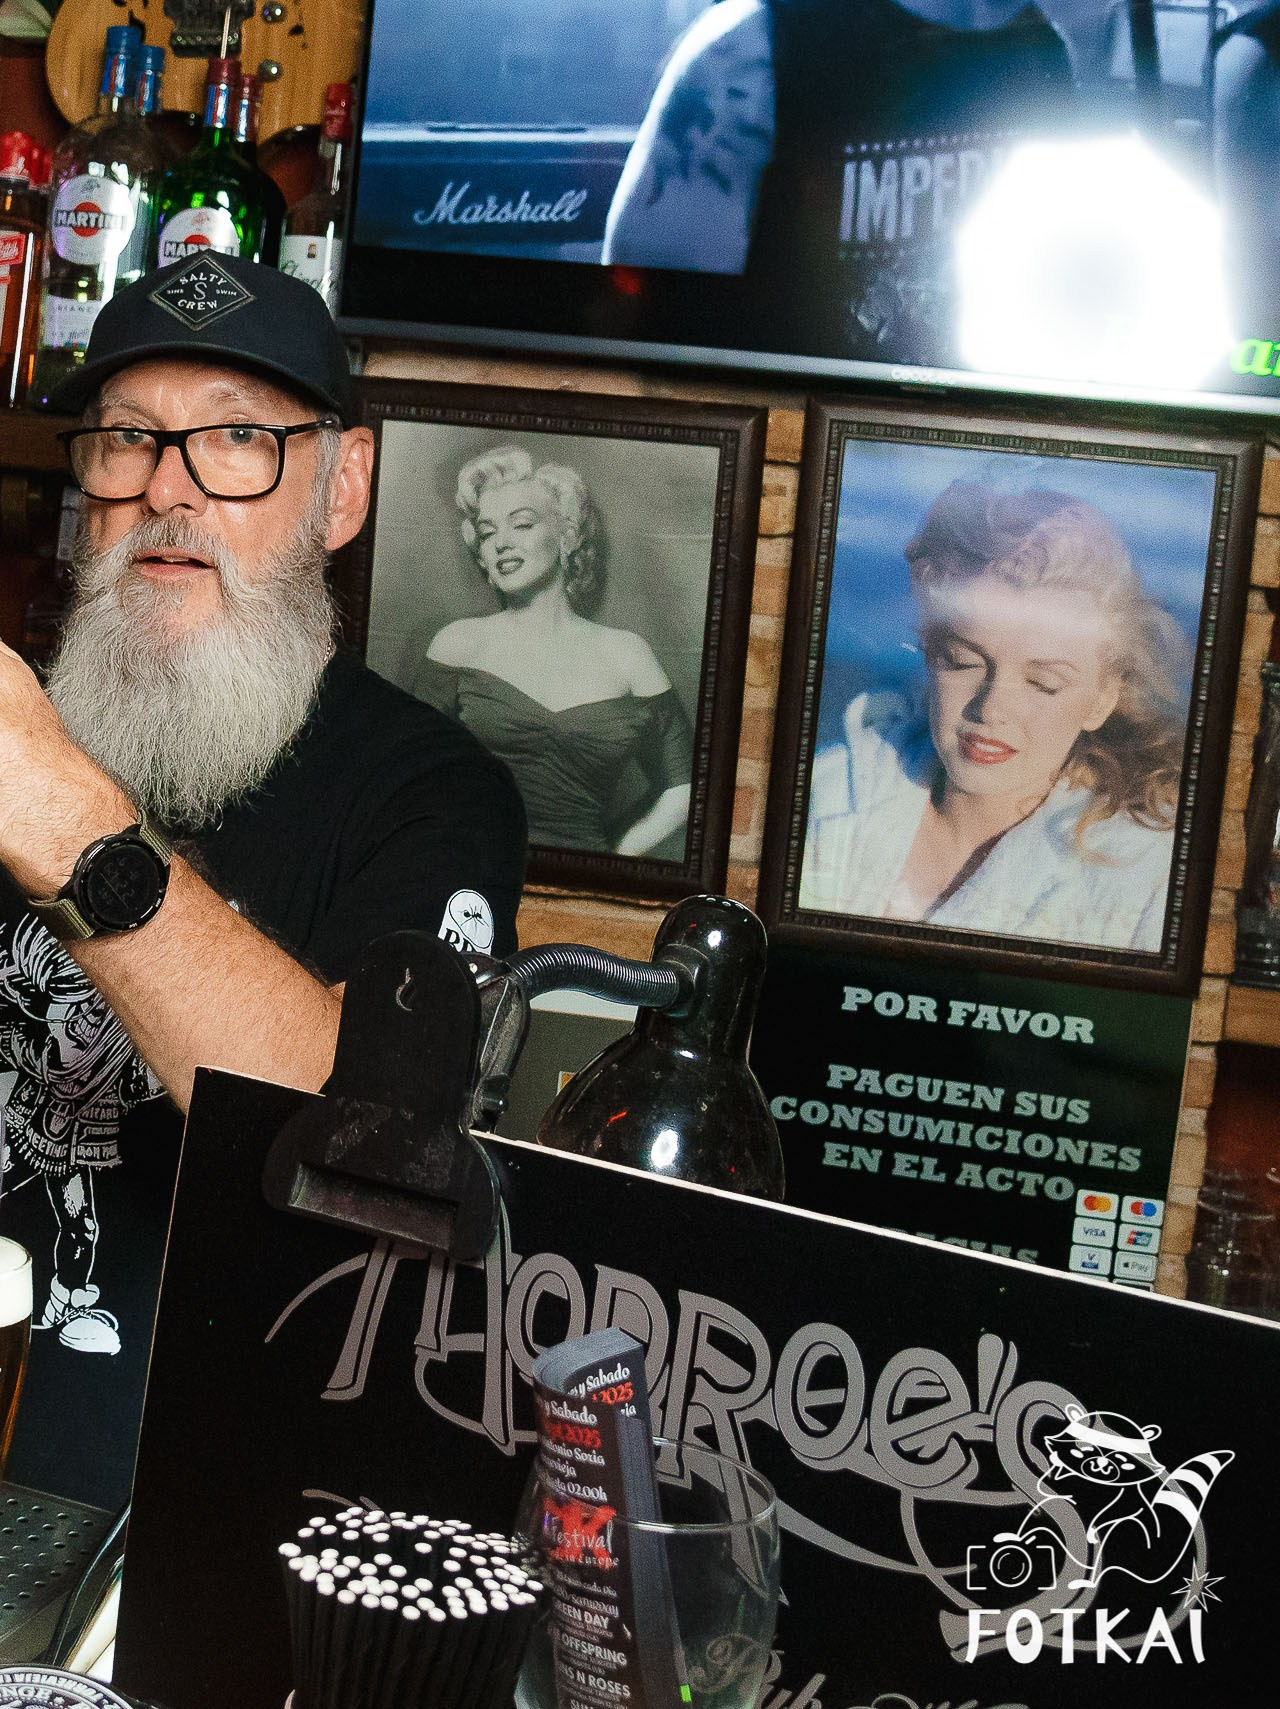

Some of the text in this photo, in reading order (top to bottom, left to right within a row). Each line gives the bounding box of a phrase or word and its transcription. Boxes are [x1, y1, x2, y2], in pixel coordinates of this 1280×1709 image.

[413, 180, 588, 225] Marshall
[180, 272, 227, 286] SALTY
[177, 299, 218, 311] CREW
[840, 985, 1095, 1045] POR FAVOR
[825, 1063, 1091, 1125] PAGUEN SUS
[768, 1095, 1143, 1173] CONSUMICIONES
[821, 1141, 1076, 1202] EN EL ACTO
[1082, 1226, 1107, 1238] VISA
[585, 1362, 631, 1392] Sabado
[551, 1400, 598, 1426] Sabado
[574, 1447, 606, 1467] Soria
[584, 1610, 609, 1629] DAY
[561, 1632, 628, 1667] OFFSPRING
[588, 1674, 631, 1699] ROSES
